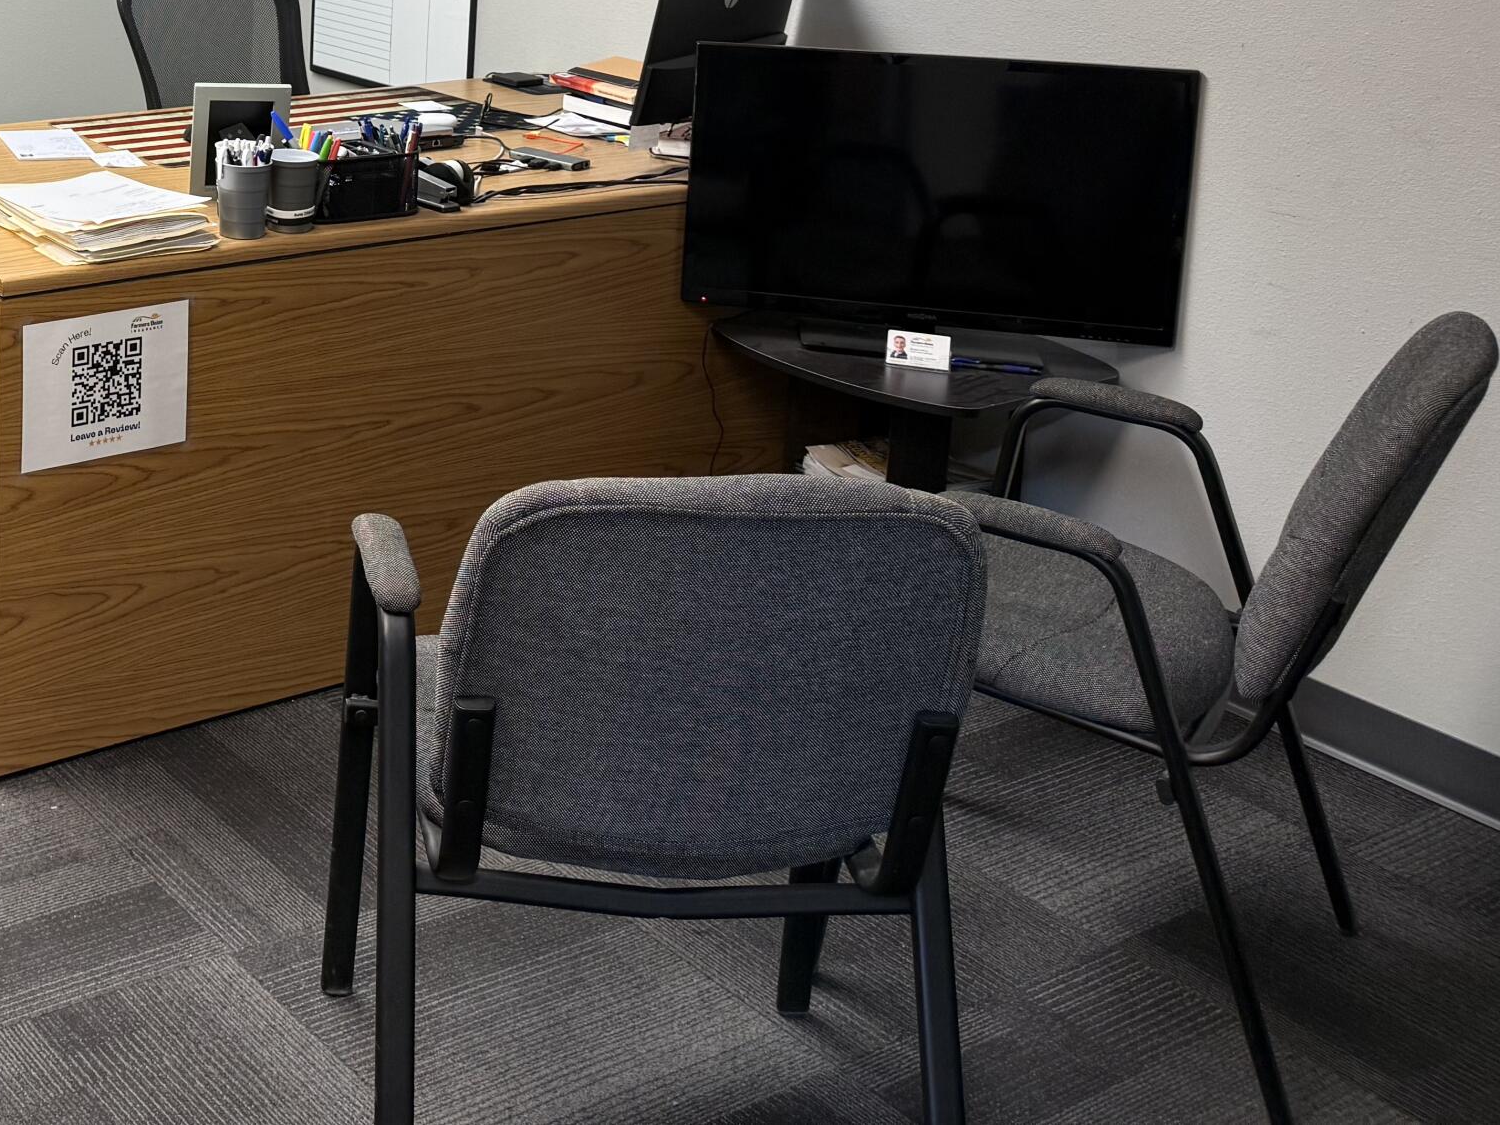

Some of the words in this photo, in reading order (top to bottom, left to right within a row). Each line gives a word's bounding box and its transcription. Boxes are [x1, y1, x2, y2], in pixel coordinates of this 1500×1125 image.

[51, 342, 69, 366] Scan
[69, 327, 92, 343] Here!
[70, 431, 96, 442] Leave
[105, 421, 141, 435] Review!
